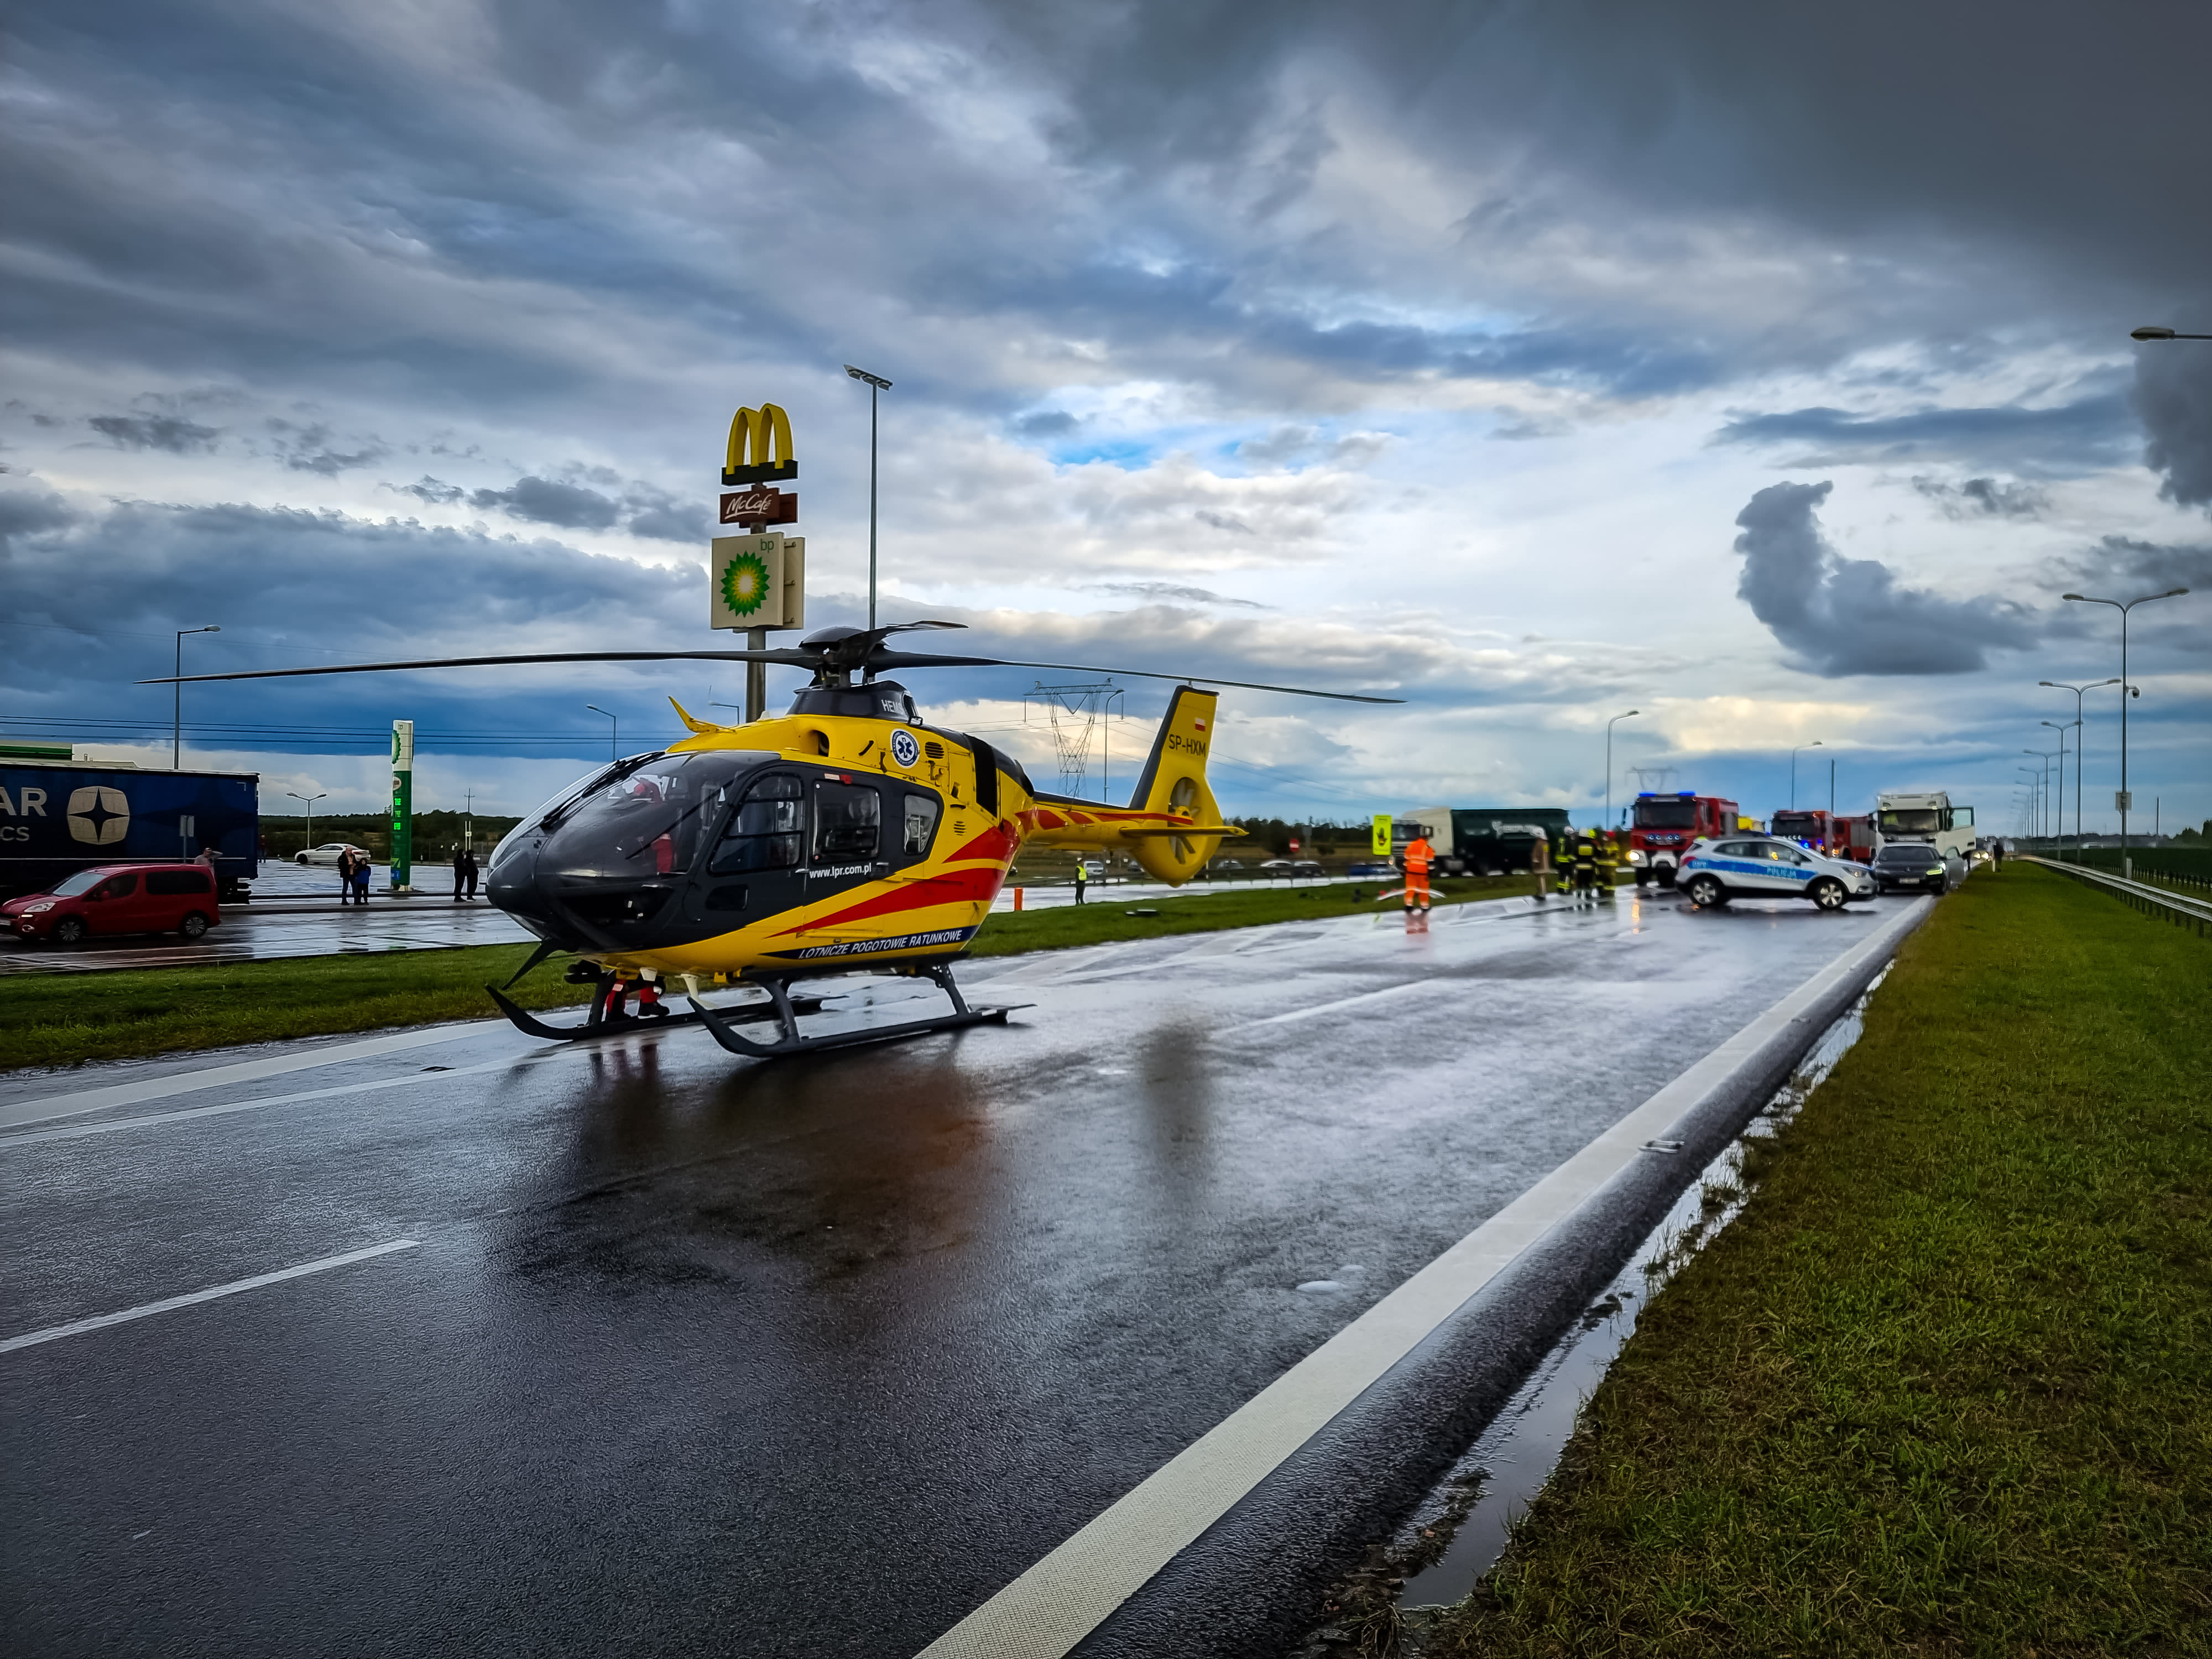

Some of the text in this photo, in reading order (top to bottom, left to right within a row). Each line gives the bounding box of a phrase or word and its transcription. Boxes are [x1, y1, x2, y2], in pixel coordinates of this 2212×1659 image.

[726, 493, 772, 515] McCafé
[760, 539, 774, 553] bp
[1168, 734, 1206, 757] SP-HXM
[809, 862, 872, 879] www.lpr.com.pl
[1767, 865, 1797, 878] POLICJA
[799, 930, 963, 959] LOTNICZE POGOTOWIE RATUNKOWE
